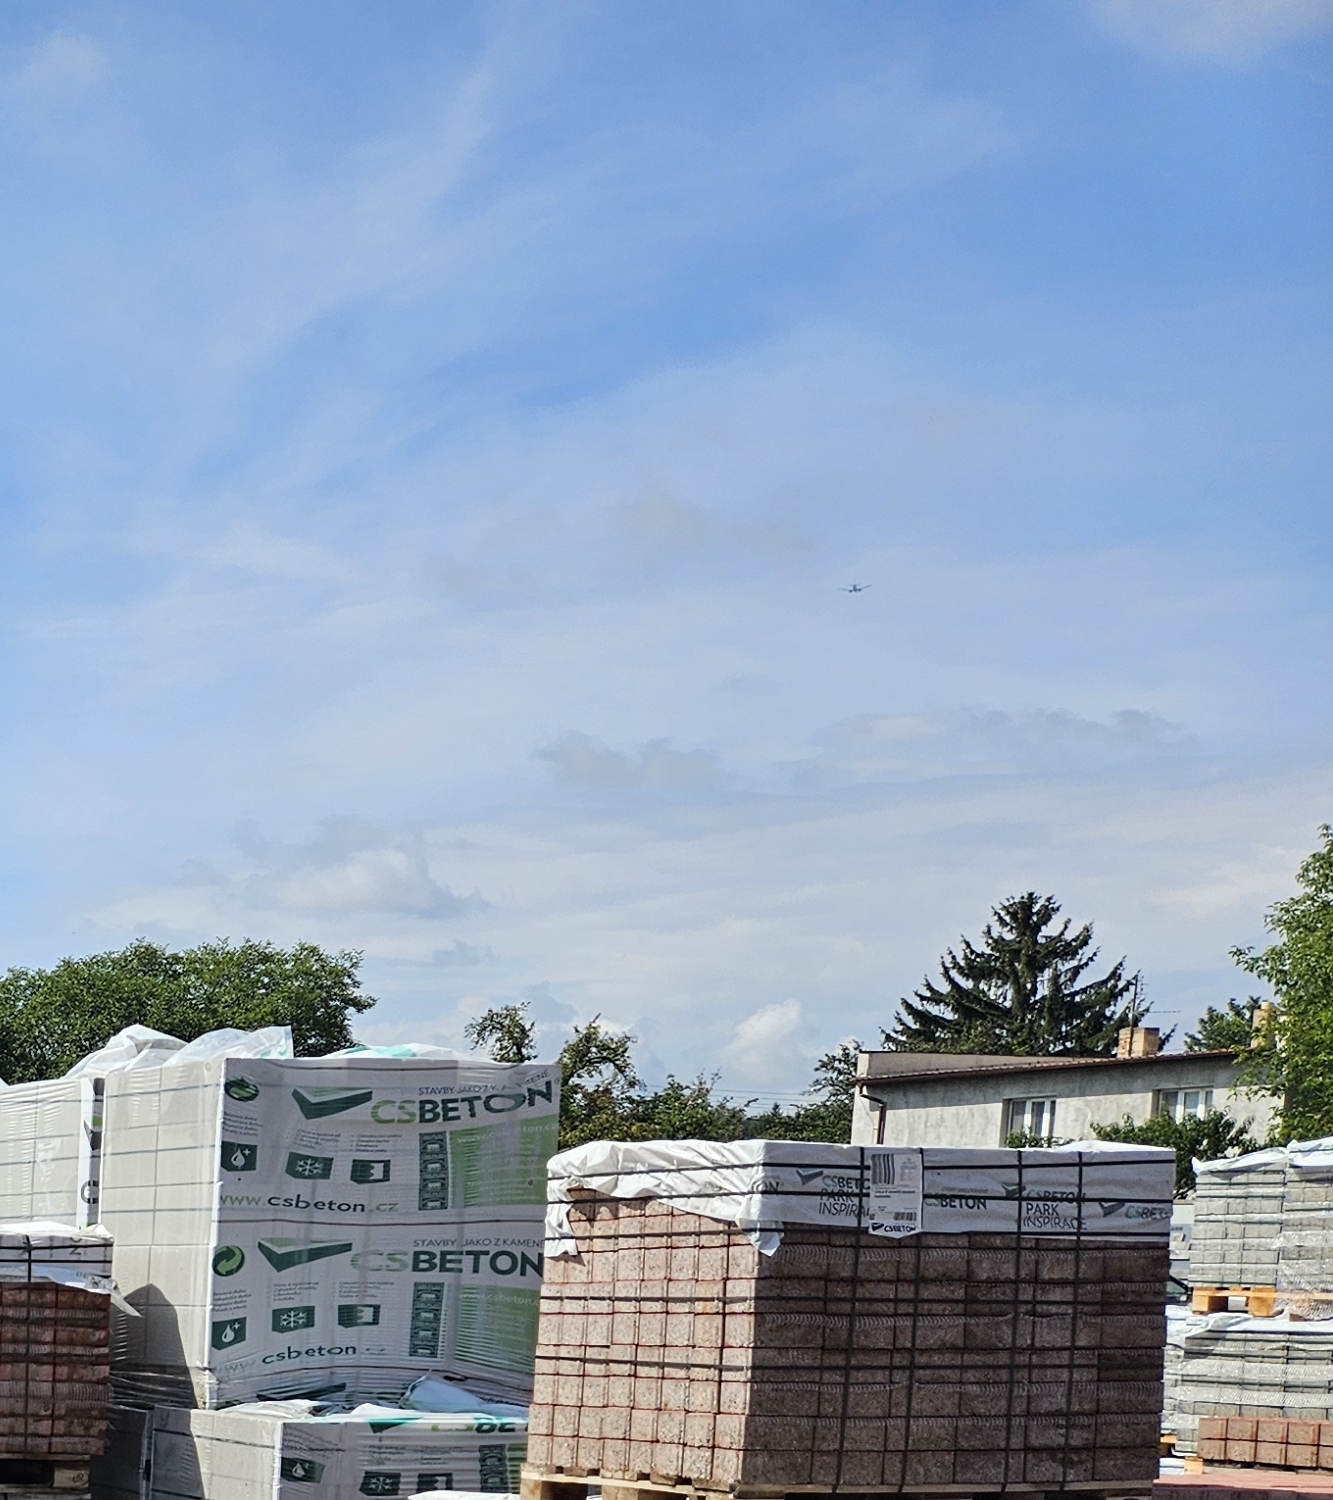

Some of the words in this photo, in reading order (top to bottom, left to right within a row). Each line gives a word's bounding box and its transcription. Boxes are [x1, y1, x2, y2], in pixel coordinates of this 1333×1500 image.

[418, 1086, 454, 1096] STAVBY
[1026, 1203, 1059, 1216] PARK
[1022, 1215, 1087, 1231] INSPIRACE
[413, 1238, 458, 1248] STAVBY
[463, 1237, 492, 1247] JAKO
[493, 1238, 501, 1247] Z
[502, 1238, 544, 1248] KAMENE
